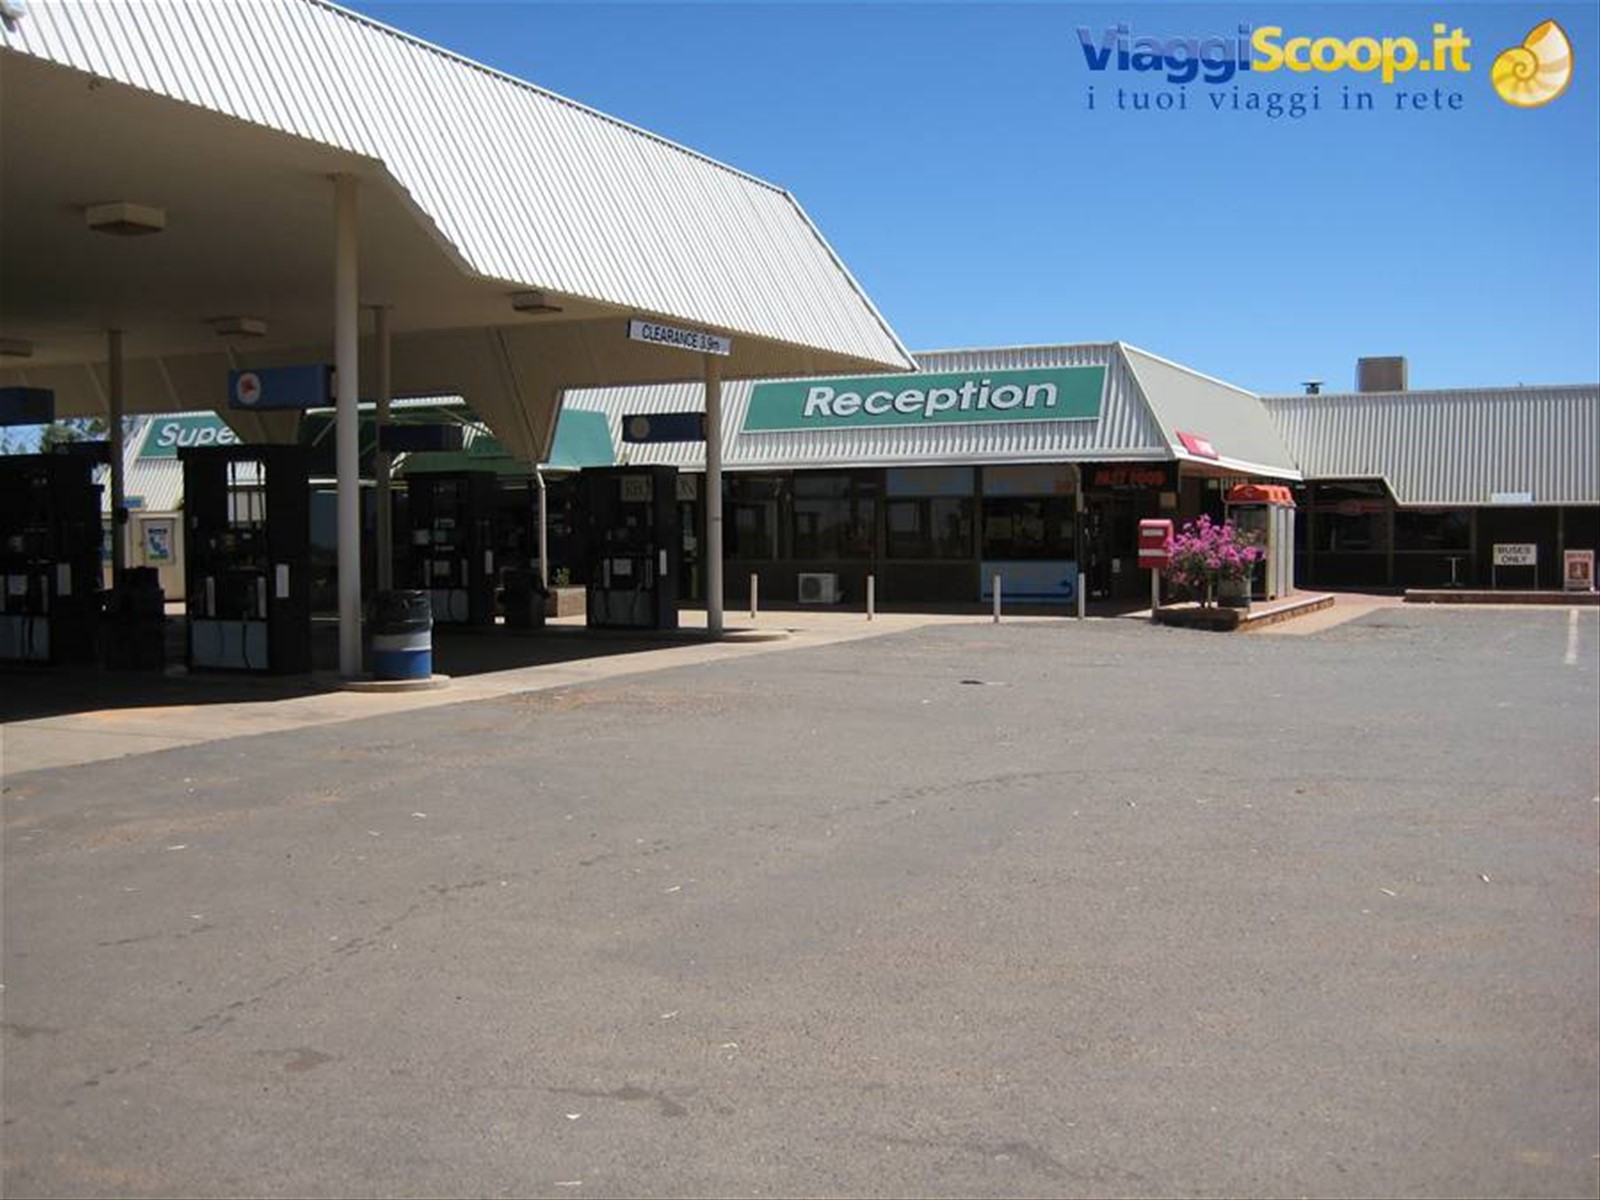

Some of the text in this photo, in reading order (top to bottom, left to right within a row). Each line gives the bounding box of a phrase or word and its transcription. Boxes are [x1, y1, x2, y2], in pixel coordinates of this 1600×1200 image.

[642, 323, 698, 348] CLEARANCE
[803, 379, 1058, 418] Reception
[1498, 546, 1531, 563] BUSES ONLY
